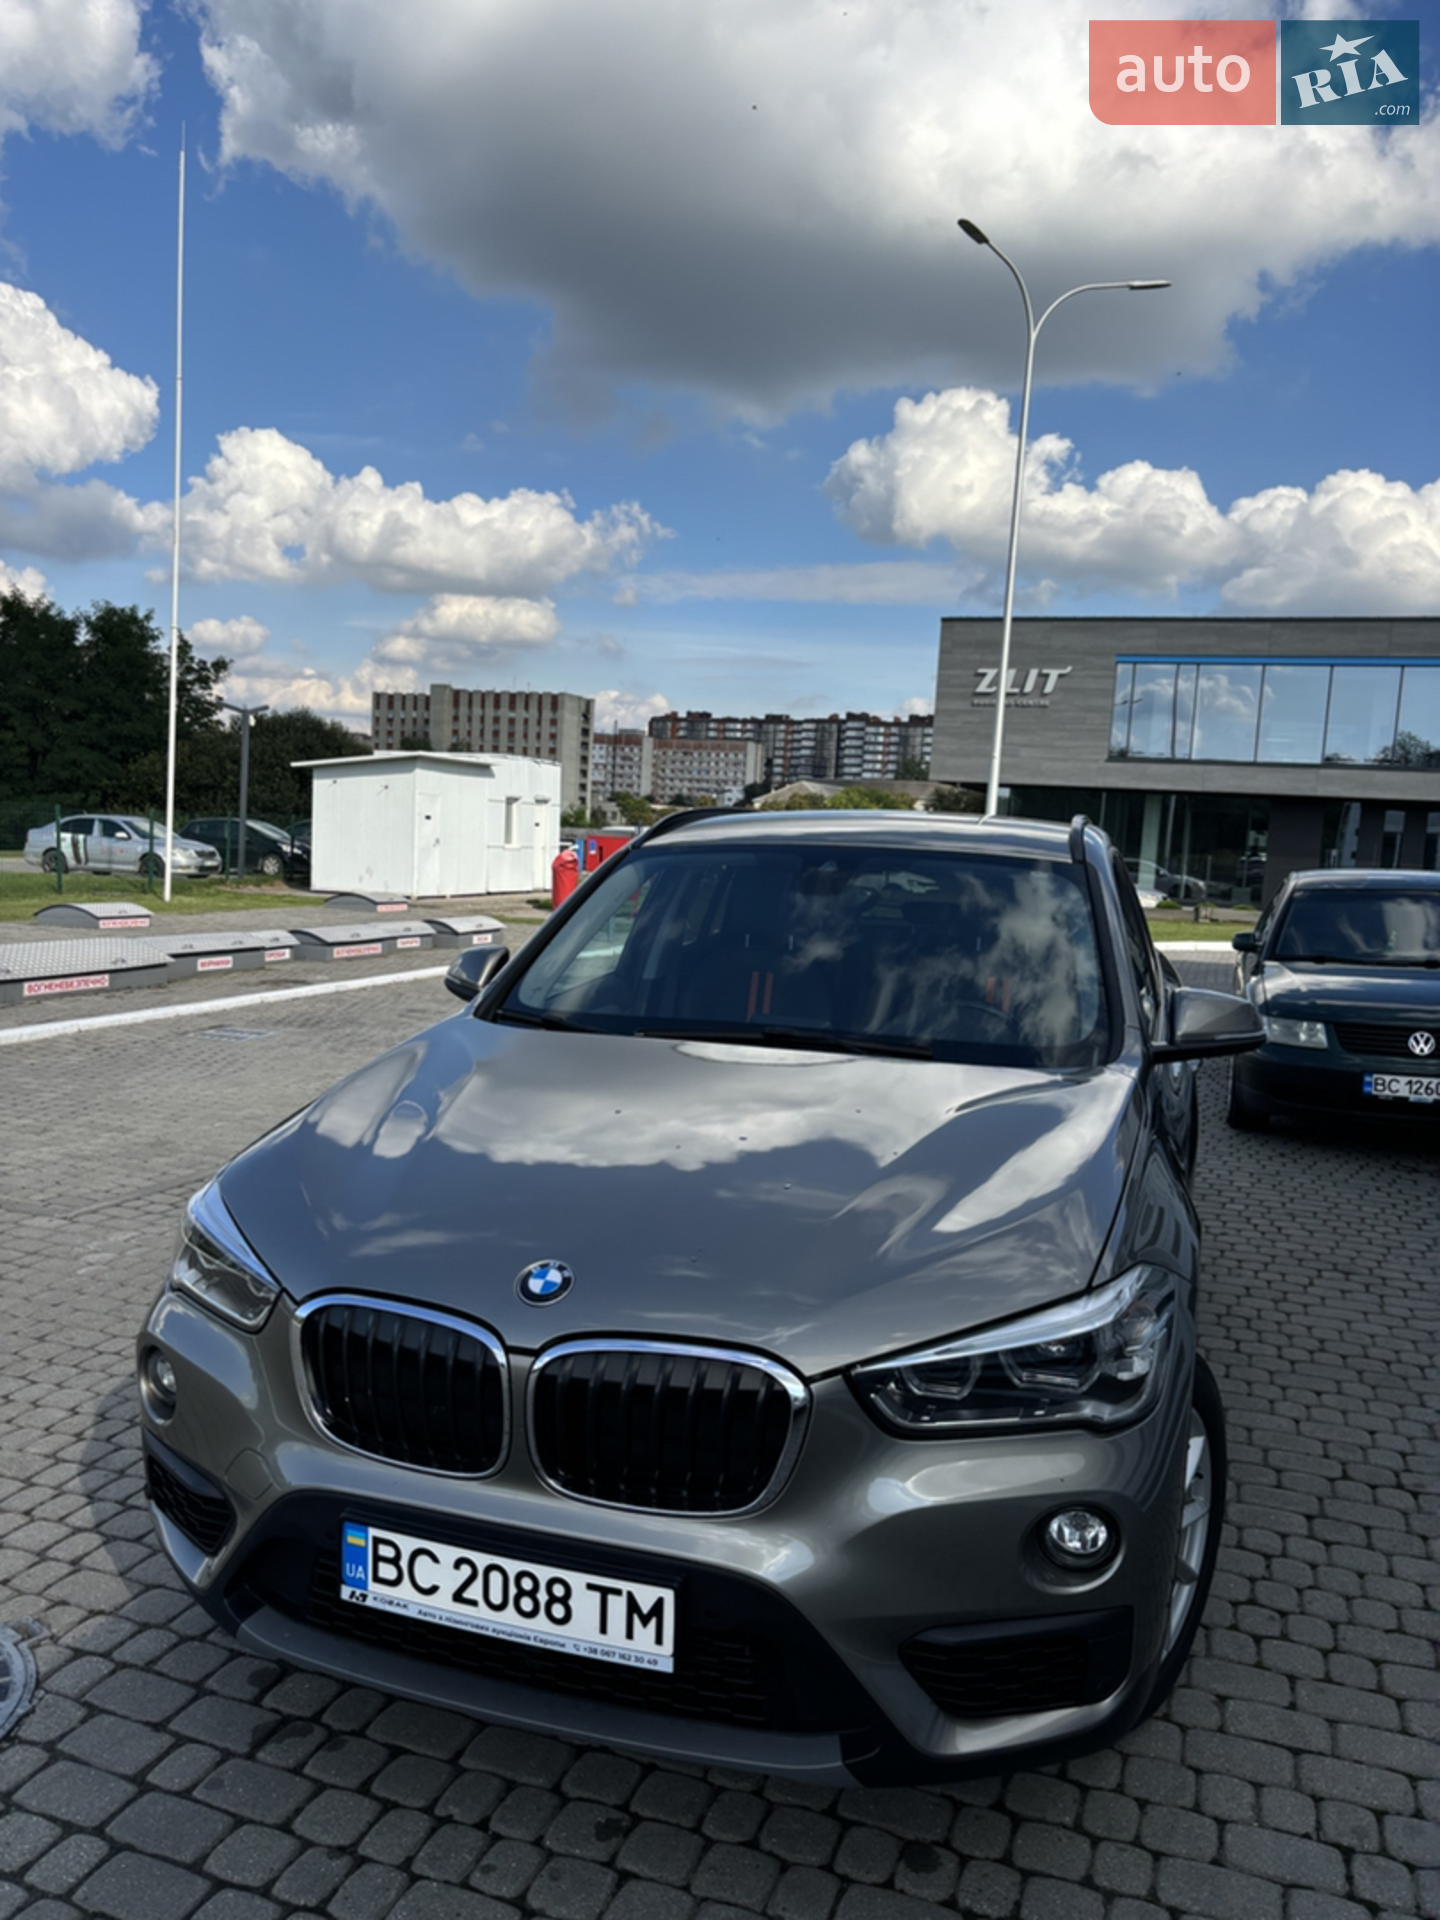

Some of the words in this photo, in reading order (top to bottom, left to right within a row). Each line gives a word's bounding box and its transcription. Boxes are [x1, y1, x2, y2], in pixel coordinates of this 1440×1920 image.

[974, 666, 1073, 694] ZLIT
[27, 976, 107, 994] ВОГНЕНЕБЕЗПЕЧНО
[1373, 1077, 1401, 1094] BC
[346, 1562, 365, 1580] UA
[372, 1535, 441, 1596] BC
[452, 1556, 573, 1626] 2088
[586, 1582, 665, 1647] TM
